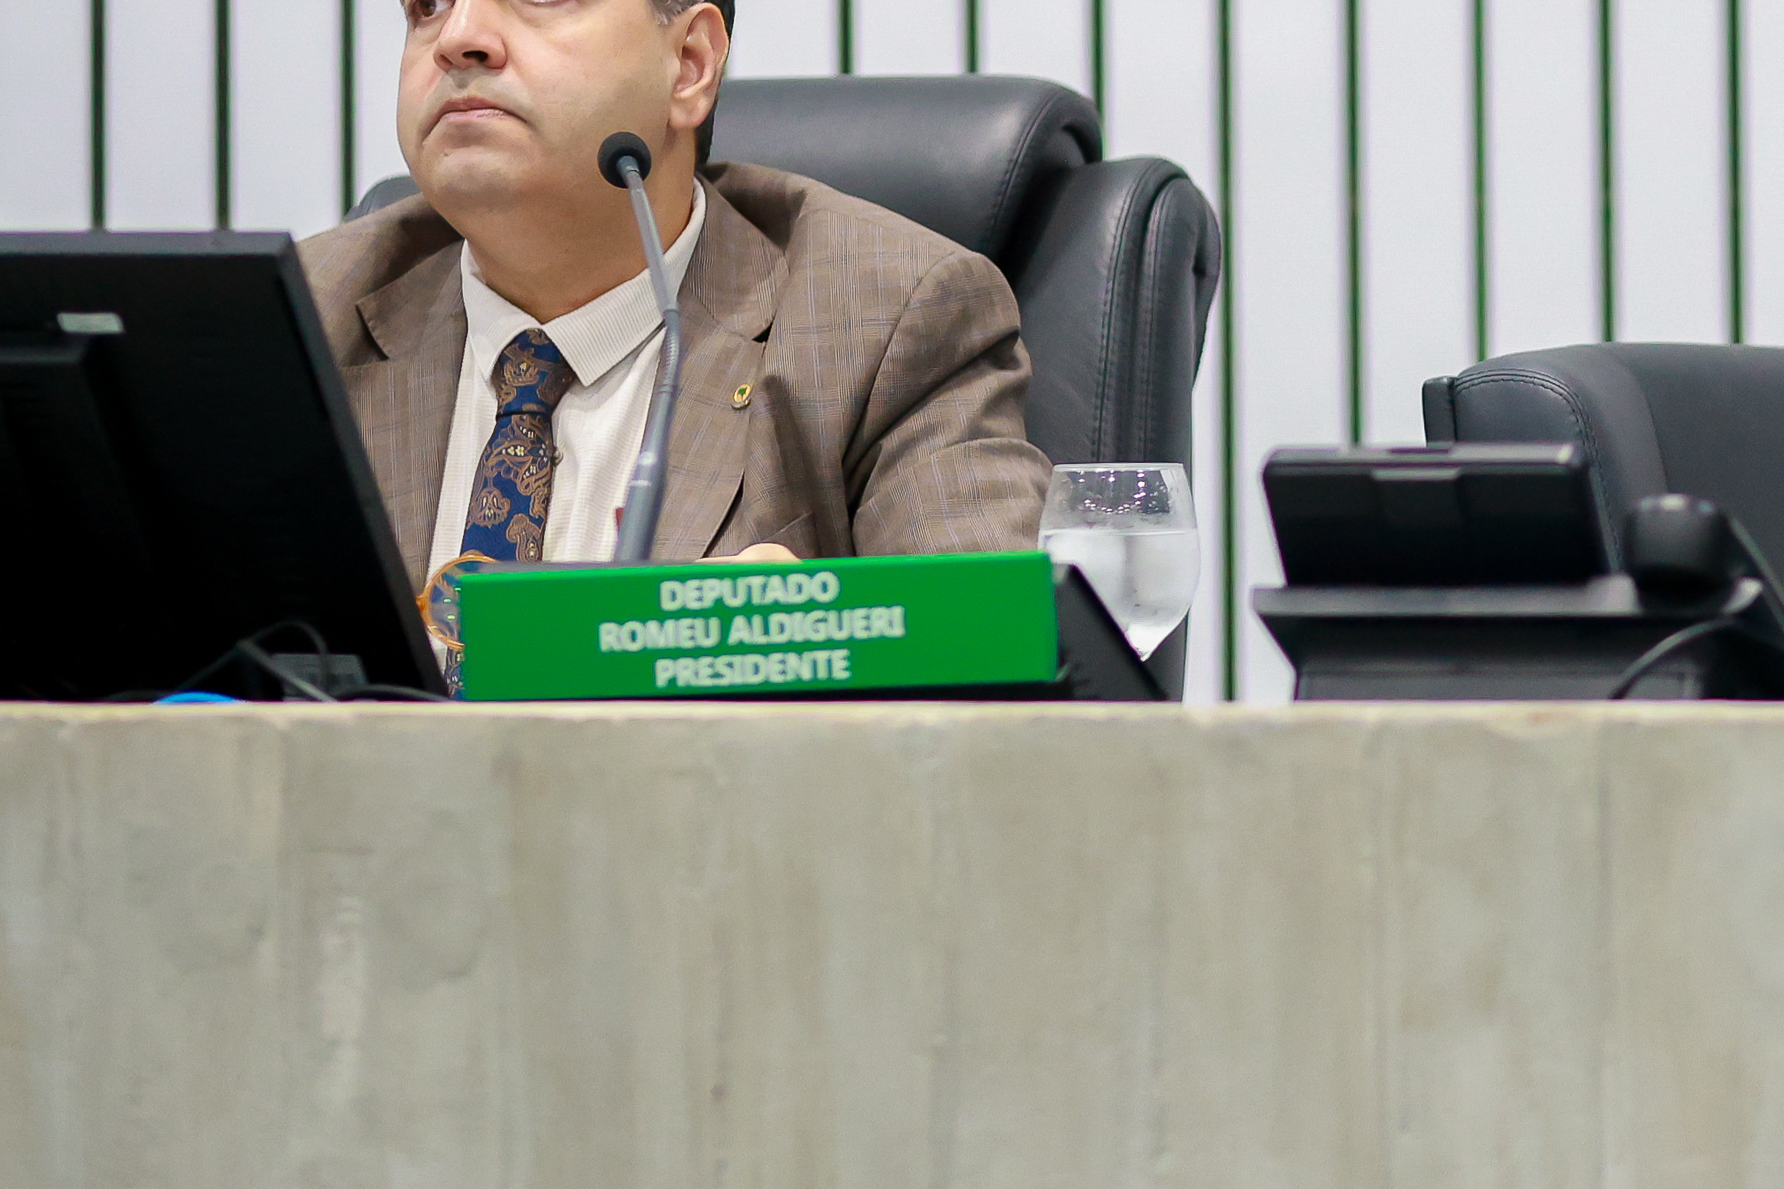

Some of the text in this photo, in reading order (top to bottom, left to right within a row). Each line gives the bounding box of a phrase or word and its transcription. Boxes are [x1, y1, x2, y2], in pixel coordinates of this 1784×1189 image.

[660, 571, 840, 610] DEPUTADO
[599, 605, 906, 652] ROMEU ALDIGUERI
[655, 648, 851, 688] PRESIDENTE
